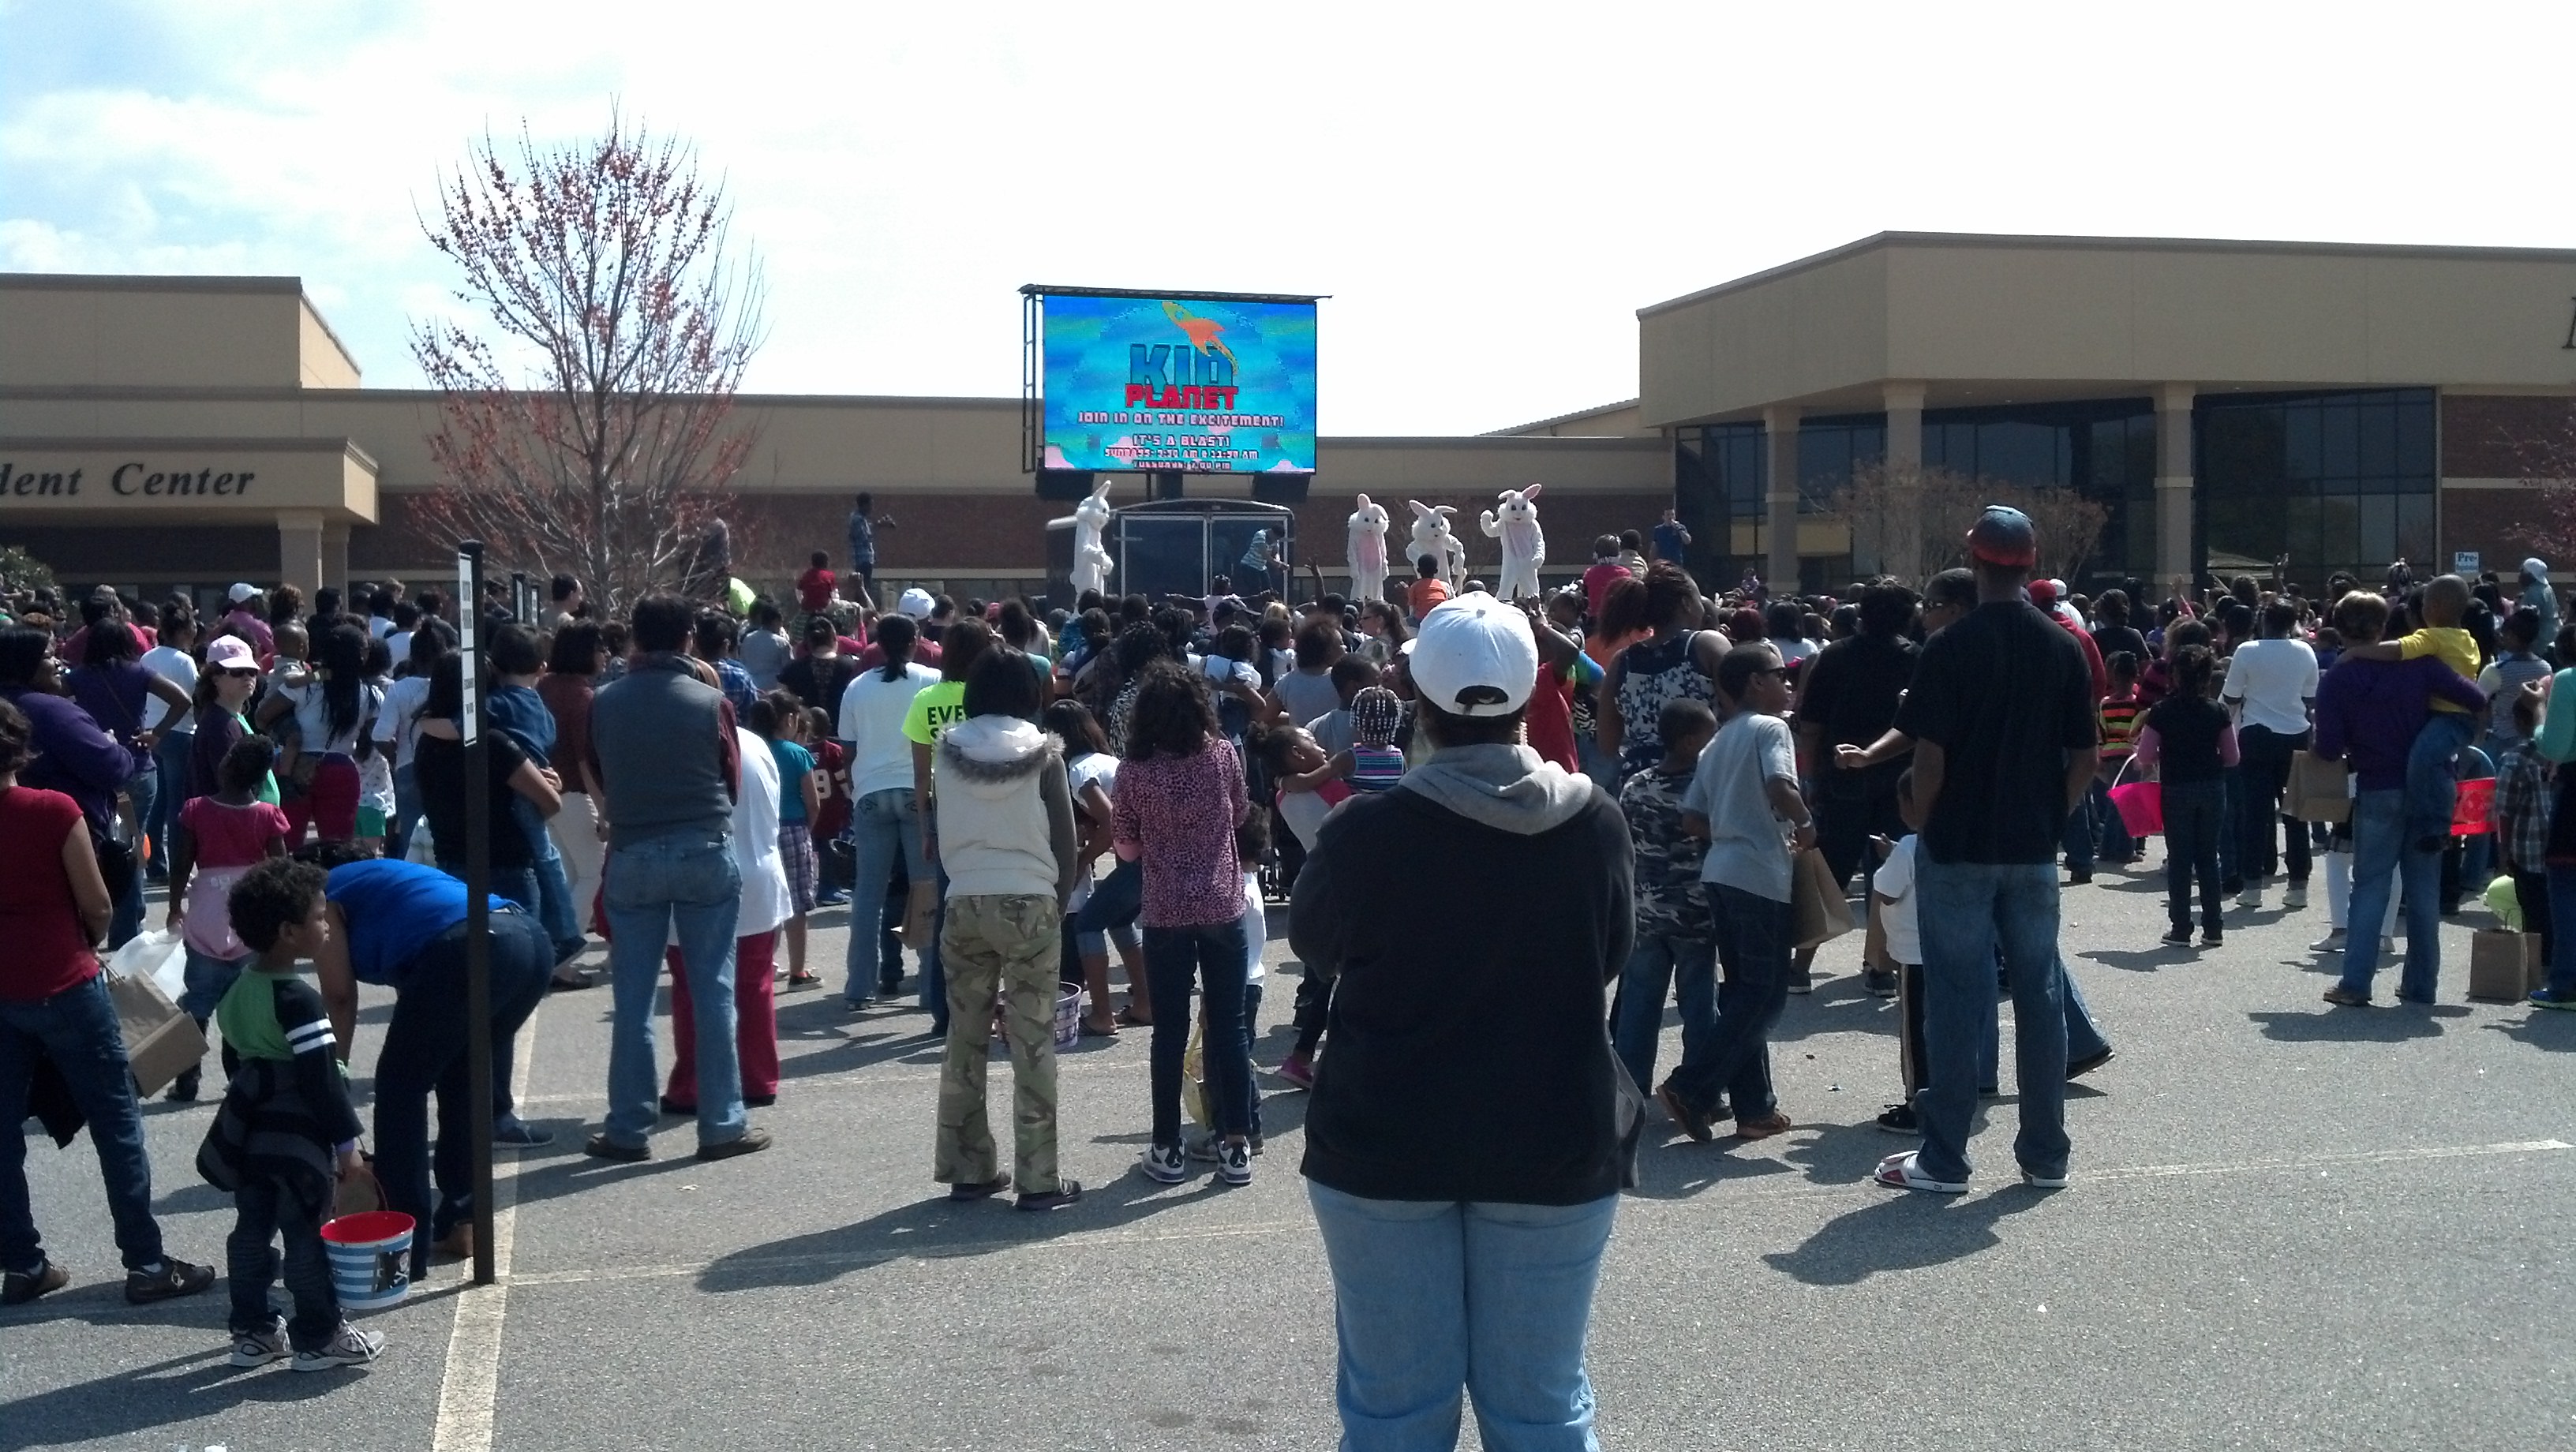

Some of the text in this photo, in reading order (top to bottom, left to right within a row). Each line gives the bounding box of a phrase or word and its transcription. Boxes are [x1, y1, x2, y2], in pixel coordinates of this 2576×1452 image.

[1129, 343, 1234, 387] KID
[1125, 384, 1238, 410] PLANET
[1078, 411, 1284, 427] JOIN IN ON THE EXCITEMENT!
[1133, 434, 1230, 447] IT'S A BLAST!
[1242, 449, 1259, 459] AM
[111, 463, 255, 495] Center
[2458, 553, 2477, 562] Pre-
[927, 705, 966, 725] EVE
